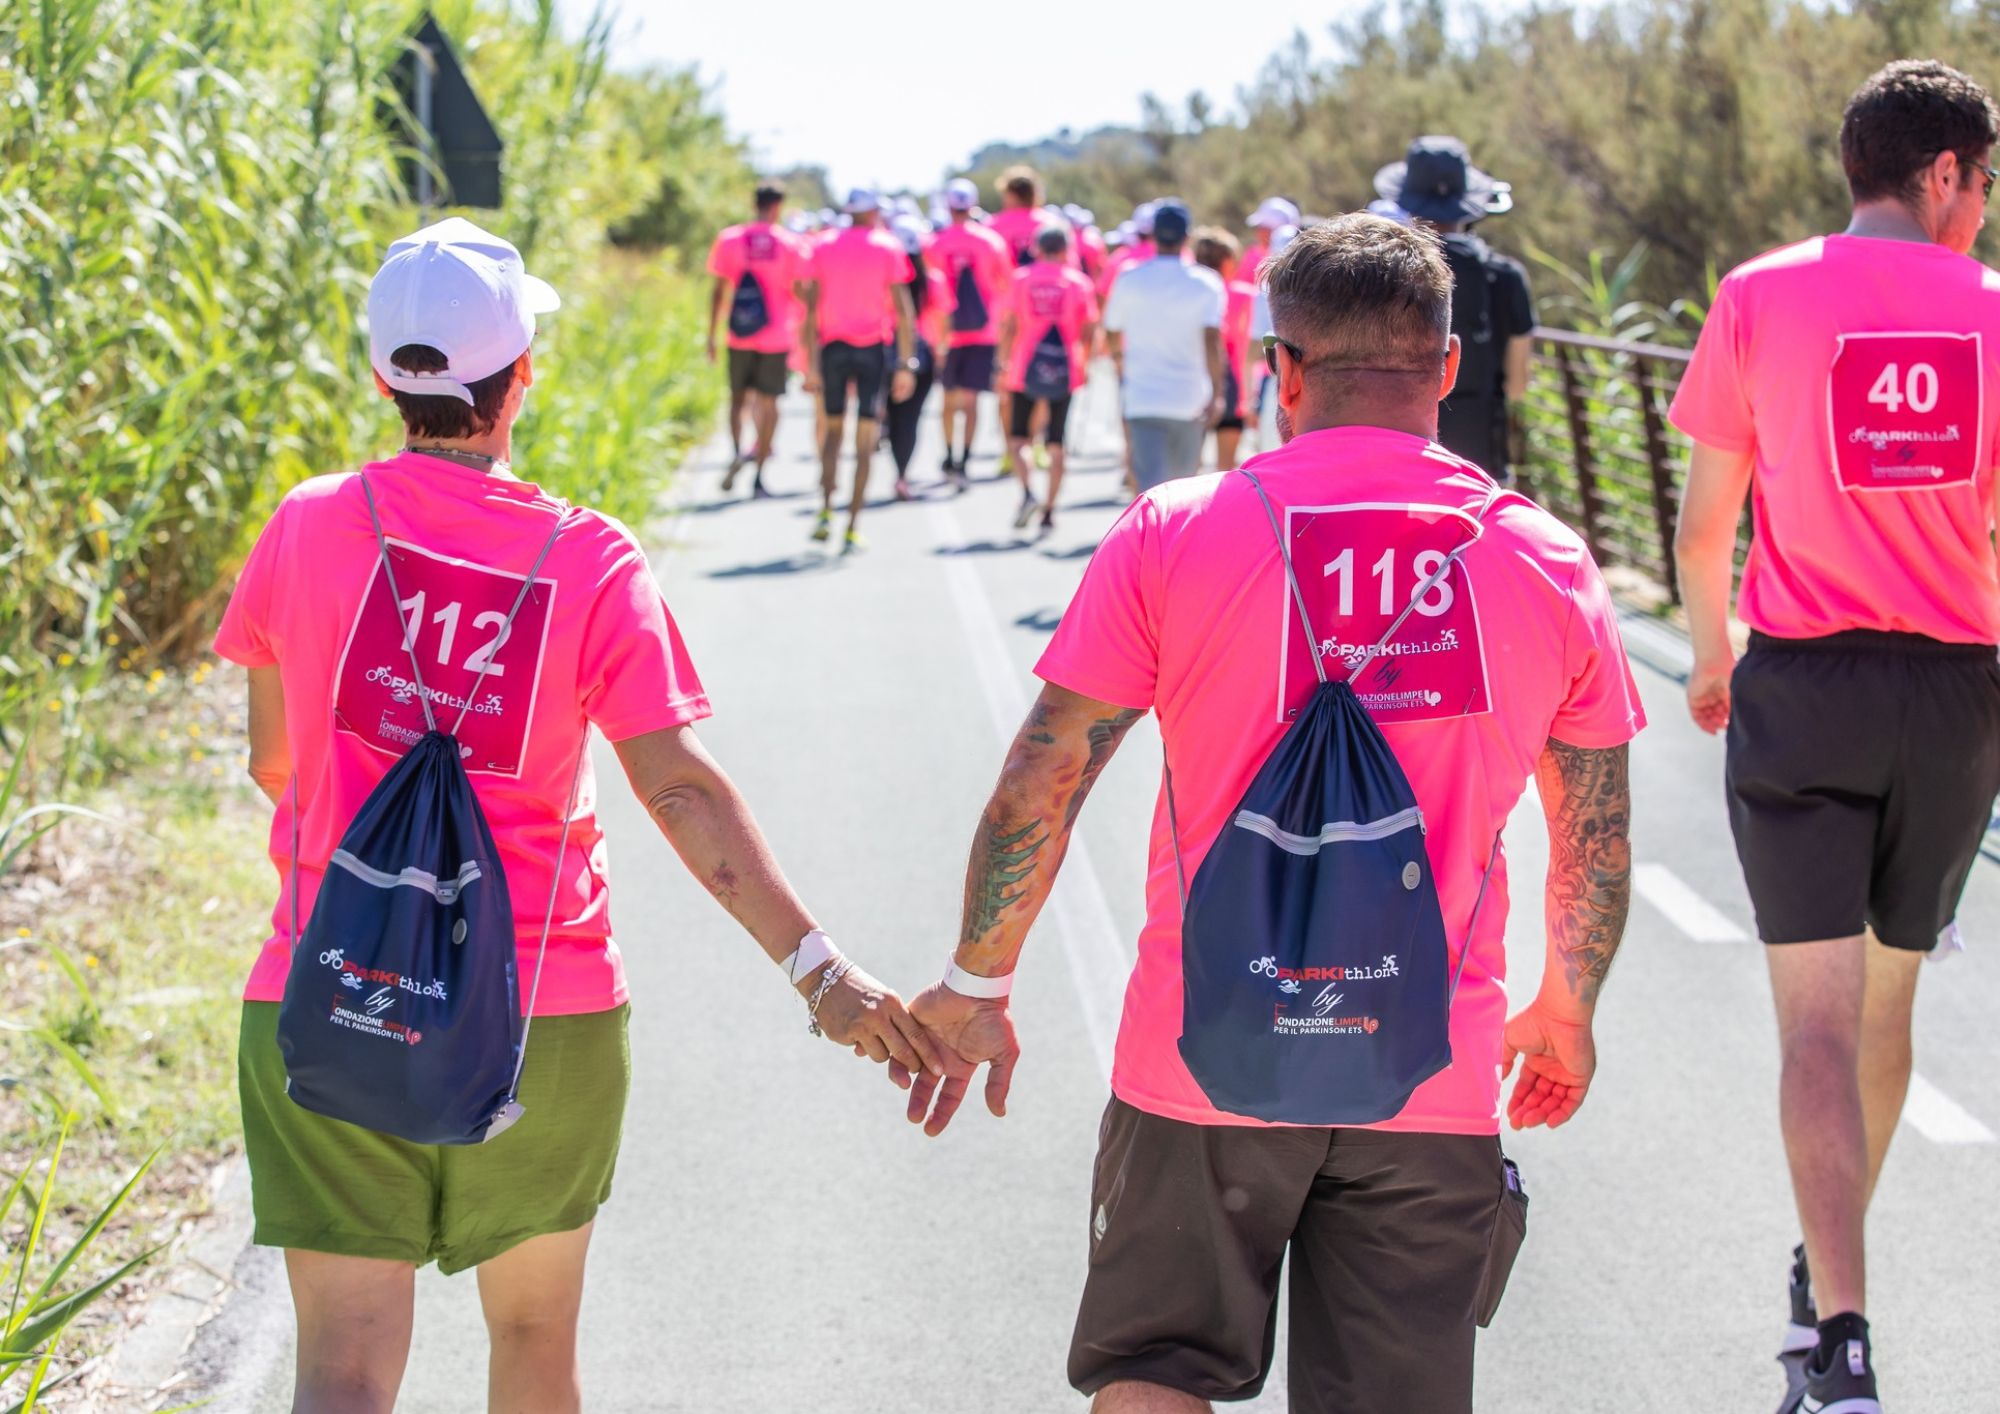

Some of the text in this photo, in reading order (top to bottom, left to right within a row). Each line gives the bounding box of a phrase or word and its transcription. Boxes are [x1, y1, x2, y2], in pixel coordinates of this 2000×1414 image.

[1867, 362, 1939, 414] 40
[1323, 548, 1455, 617] 118
[400, 590, 512, 677] 112
[364, 986, 396, 1015] by
[1312, 982, 1345, 1016] by
[352, 1022, 392, 1038] PARKINSON
[1274, 1026, 1362, 1035] PER IL PARKINSON ETS
